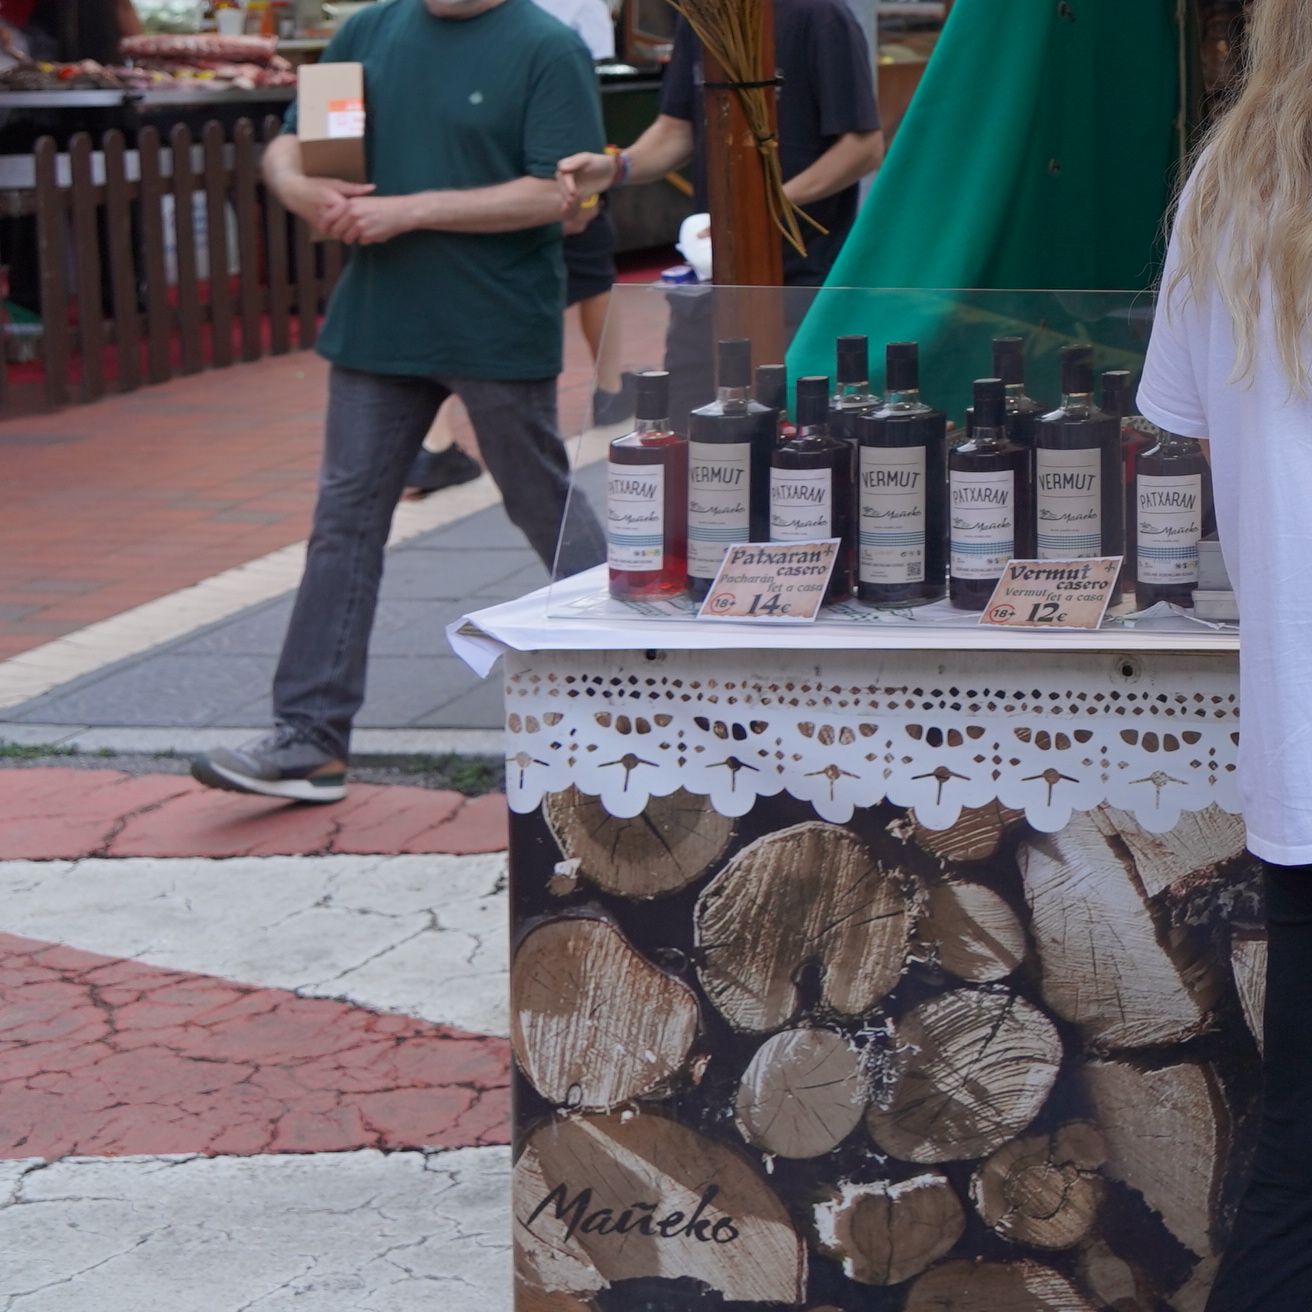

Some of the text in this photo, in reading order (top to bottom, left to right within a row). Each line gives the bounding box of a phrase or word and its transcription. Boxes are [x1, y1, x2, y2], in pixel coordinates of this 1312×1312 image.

[862, 470, 921, 489] VERMUT
[1039, 473, 1096, 491] VERMUT
[953, 487, 1009, 505] PATXARAN
[1140, 491, 1196, 510] PATXARAN
[731, 548, 822, 565] Patxaran
[776, 565, 826, 576] casero
[1009, 564, 1092, 581] Vermut
[797, 584, 822, 592] casa
[1056, 580, 1108, 590] casero
[714, 598, 736, 608] 18+
[1077, 593, 1104, 601] casa
[993, 609, 1016, 618] 18+
